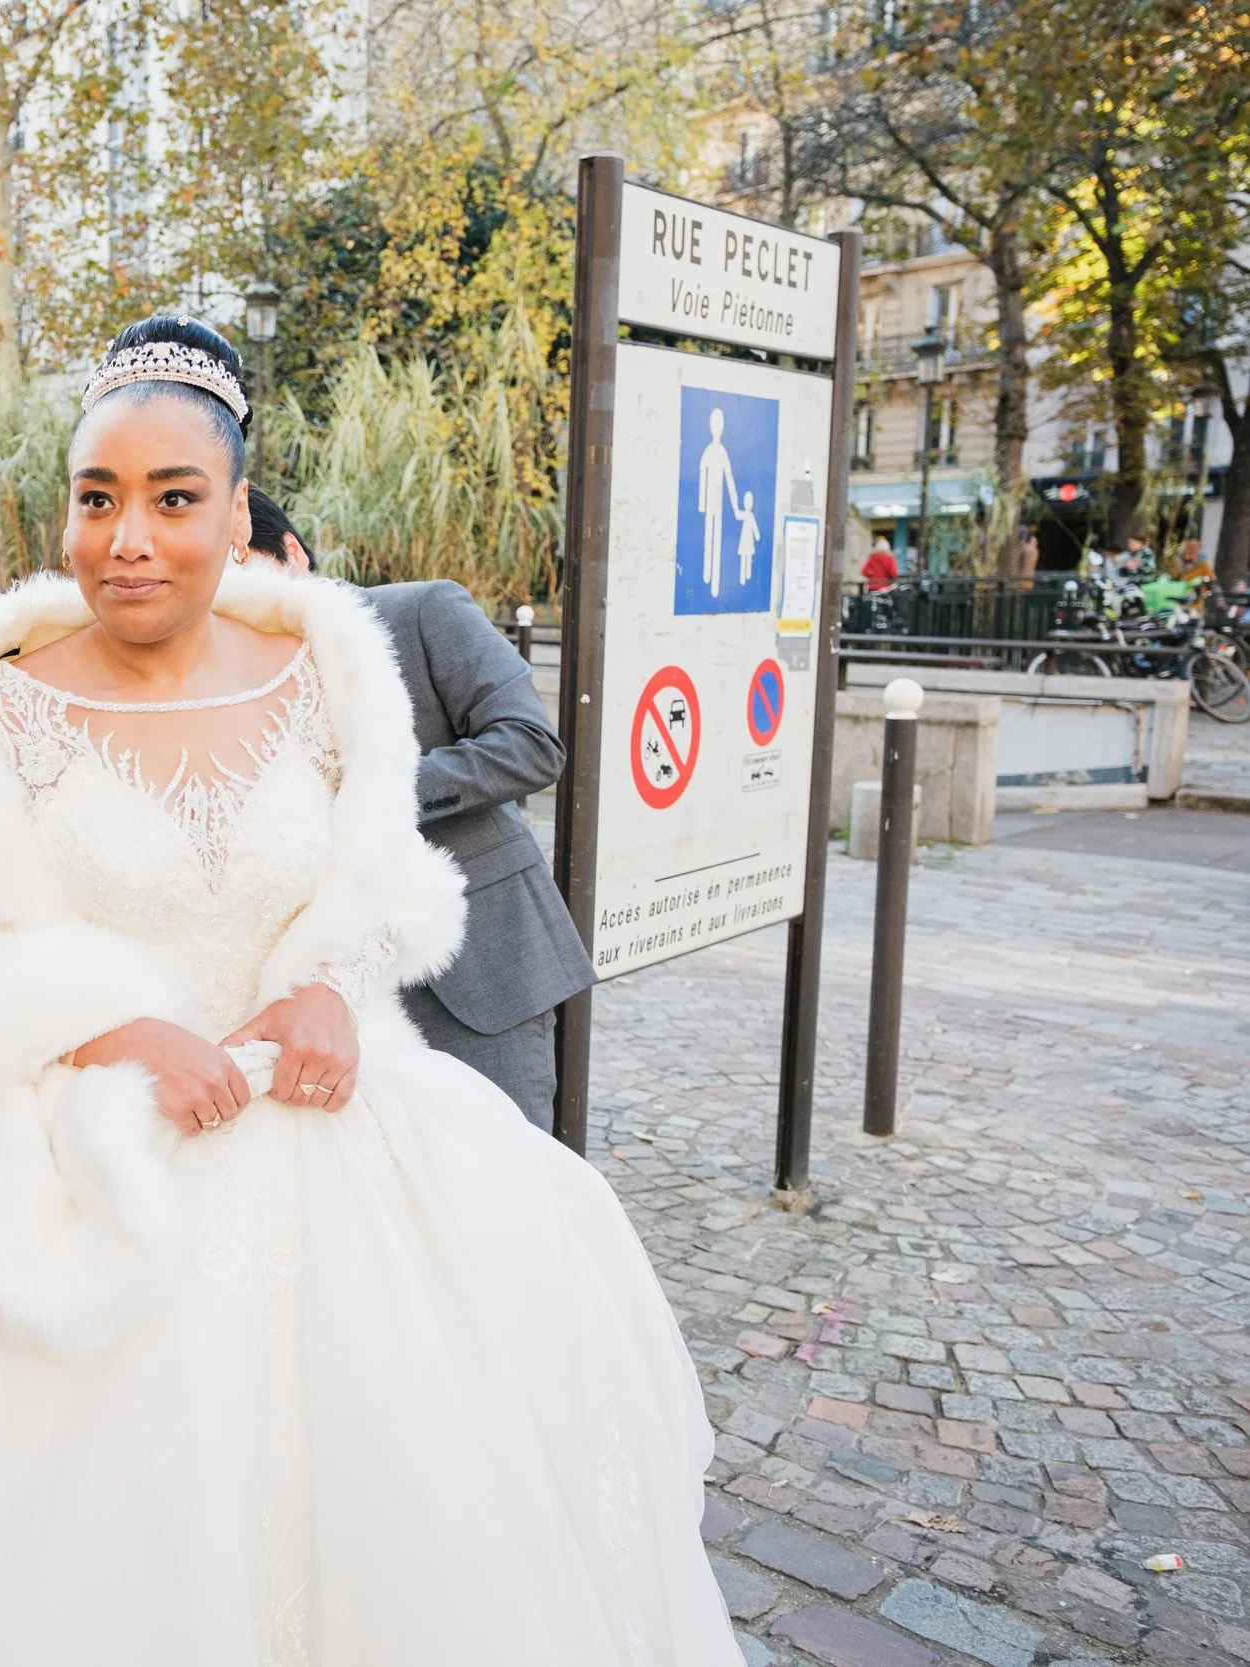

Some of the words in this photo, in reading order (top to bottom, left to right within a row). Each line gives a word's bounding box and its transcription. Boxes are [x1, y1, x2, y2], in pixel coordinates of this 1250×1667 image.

[653, 209, 703, 265] RUE
[724, 229, 813, 292] PECLET
[671, 277, 710, 319] Voie
[720, 290, 794, 336] Piétonne
[598, 947, 620, 967] aux
[628, 926, 684, 957] riverains
[690, 919, 703, 937] et
[708, 912, 728, 932] aux
[733, 896, 784, 924] livraisons
[599, 903, 640, 931] Accès
[707, 884, 720, 900] en
[727, 863, 792, 899] permanence
